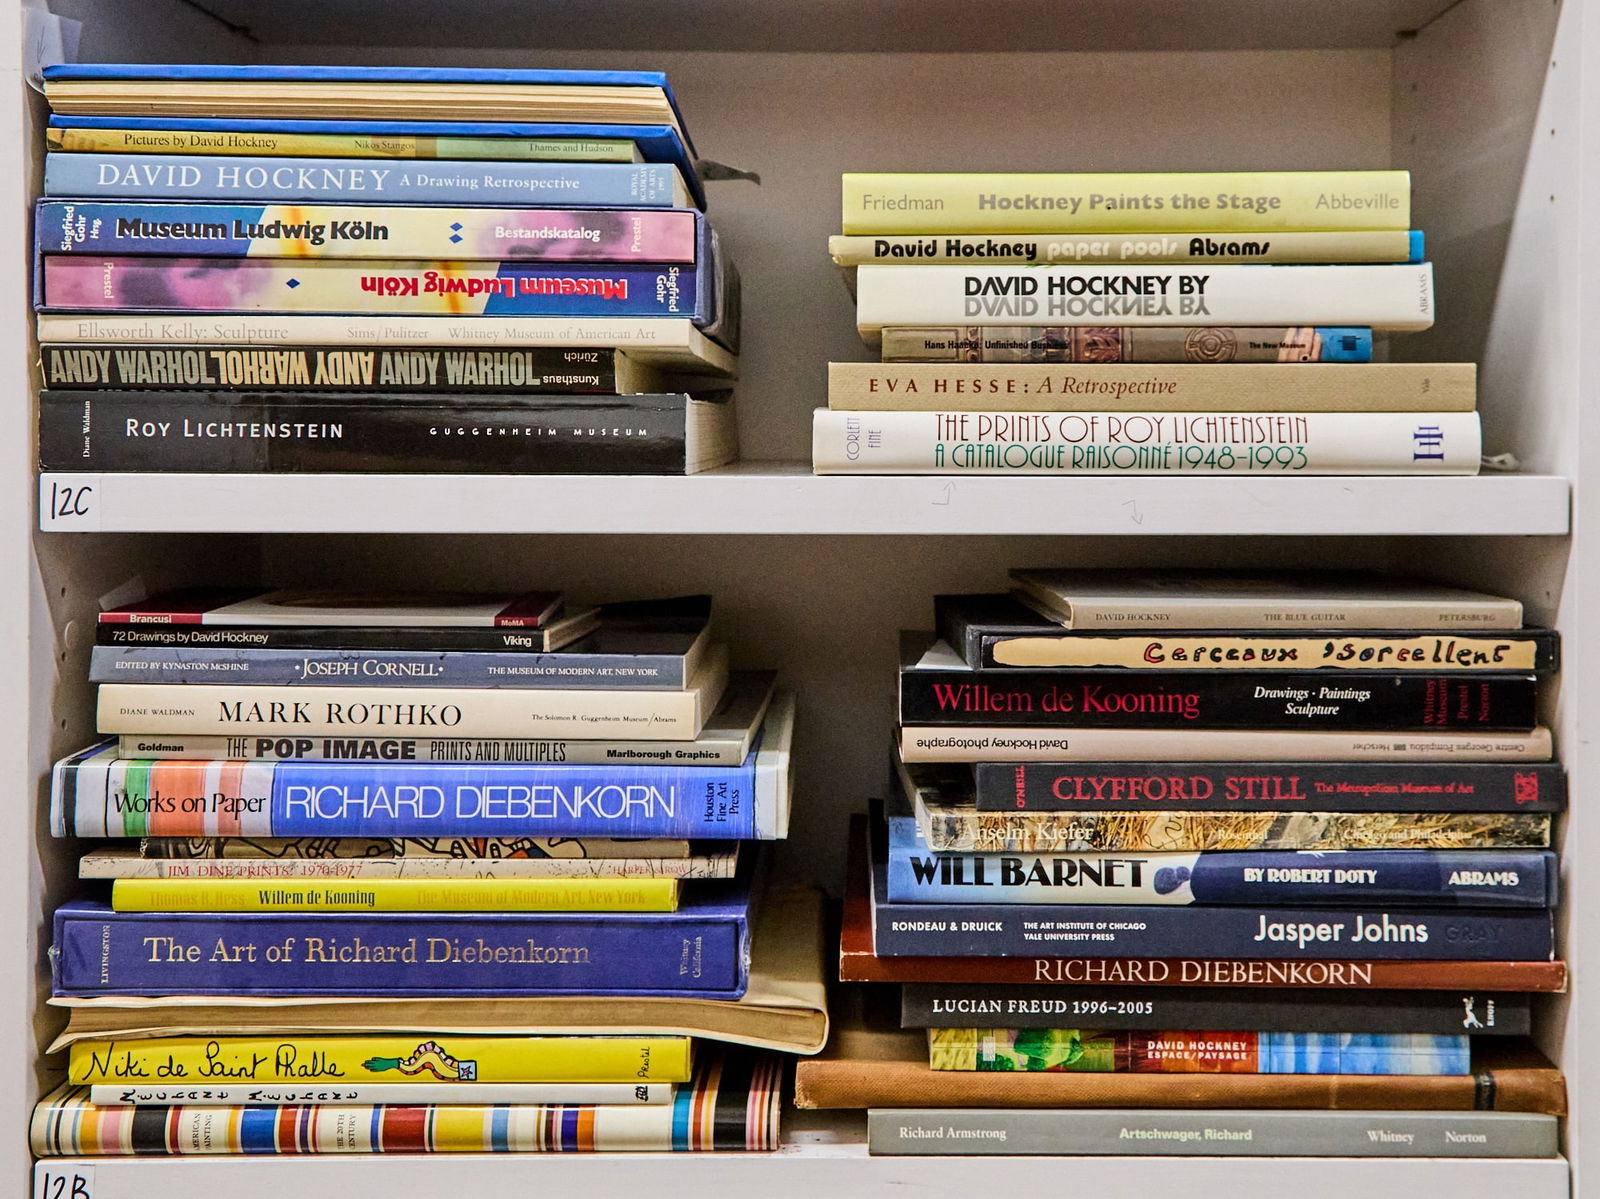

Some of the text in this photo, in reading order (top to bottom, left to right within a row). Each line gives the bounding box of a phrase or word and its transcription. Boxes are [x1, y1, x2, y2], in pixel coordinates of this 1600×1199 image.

[124, 133, 277, 149] Pictures by David Hockney
[529, 143, 613, 154] Thames and Hudson
[98, 164, 391, 191] DAVID HOCKNEY
[400, 175, 581, 192] A Drawing Retrospective
[862, 194, 944, 210] Friedman
[979, 193, 1281, 215] Hockney Paints the Stage
[1315, 193, 1399, 209] Abbeville
[61, 206, 75, 251] Siegfried
[75, 215, 87, 243] Gohr
[116, 218, 389, 246] Museum Ludwig Köln
[496, 226, 601, 243] Bestandskatalog
[631, 217, 641, 253] Prestel
[874, 238, 1270, 261] David Hockney paper pools Abrams
[104, 262, 115, 299] Prestel
[361, 271, 628, 300] Museum Ludwig Köln
[656, 275, 667, 304] Gohr
[964, 276, 1210, 296] DAVID HOCKNEY BY
[667, 267, 680, 313] Siegfried
[77, 323, 289, 343] Ellsworth Kelly: Sculpture
[448, 327, 656, 342] Whitney Museum of American Art
[50, 349, 217, 384] ANDY WARHOL
[210, 351, 375, 385] ANDY WARHOL
[380, 351, 541, 386] ANDY WARHOL
[542, 374, 599, 386] Kunsthaus
[869, 377, 1177, 400] EVA HESSE: A Retrospective
[430, 427, 648, 437] GUGGENHEIM MUSEUM
[935, 413, 1308, 444] THE PRINTS OF ROY LICHTENSTEIN
[935, 445, 945, 467] A
[952, 444, 1065, 469] CATALOGUE
[1072, 441, 1171, 469] RAISONNÉ
[50, 482, 92, 519] 12C
[129, 614, 172, 624] Brancusi
[112, 631, 268, 645] 72 Drawings by David Hockney
[503, 635, 532, 647] Viking
[932, 683, 1200, 719] Willem de Kooning
[1254, 686, 1371, 702] Drawings Paintings
[120, 708, 195, 716] DIANE WALDMAN
[218, 701, 462, 726] MARK ROTHKO
[1285, 703, 1339, 717] Sculpture
[137, 742, 184, 752] Goldman
[226, 738, 566, 762] THE POP IMAGE PRINTS AND MULTIPLES
[917, 738, 1068, 750] David Hockney photographe
[607, 749, 720, 760] Marlborough Graphics
[1052, 776, 1306, 801] CLYFFORD STILL
[114, 791, 266, 820] Works on Paper
[286, 785, 674, 818] RICHARD DIEBENKORN
[704, 782, 715, 823] Houston
[960, 822, 1094, 840] Anselm Kiefer
[909, 856, 1148, 887] WILL BARNET
[1244, 868, 1377, 884] BY ROBERT DOTY
[1449, 871, 1519, 886] ABRAMS
[259, 890, 375, 907] Willem de Kooning
[892, 921, 1003, 932] RONDEAU & DRUICK
[1024, 922, 1147, 930] THE ART INSTITUTE OF CHICAGO
[1254, 914, 1429, 949] Jasper Johns
[1024, 933, 1115, 942] YALE UNIVERSITY PRESS
[143, 937, 591, 964] The Art of Richard Diebenkorn
[1034, 959, 1373, 985] RICHARD DIEBENKORN
[932, 999, 1001, 1013] LUCIAN
[1007, 1000, 1067, 1014] FREUD
[1147, 1041, 1247, 1051] DAVID HOCKNEY
[1147, 1052, 1247, 1061] ESPACE/PAYSAGE
[900, 1127, 1007, 1141] Richard Armstrong
[1120, 1128, 1252, 1141] Artschwager, Richard
[1367, 1130, 1415, 1144] Whitney
[1445, 1131, 1487, 1143] Norton
